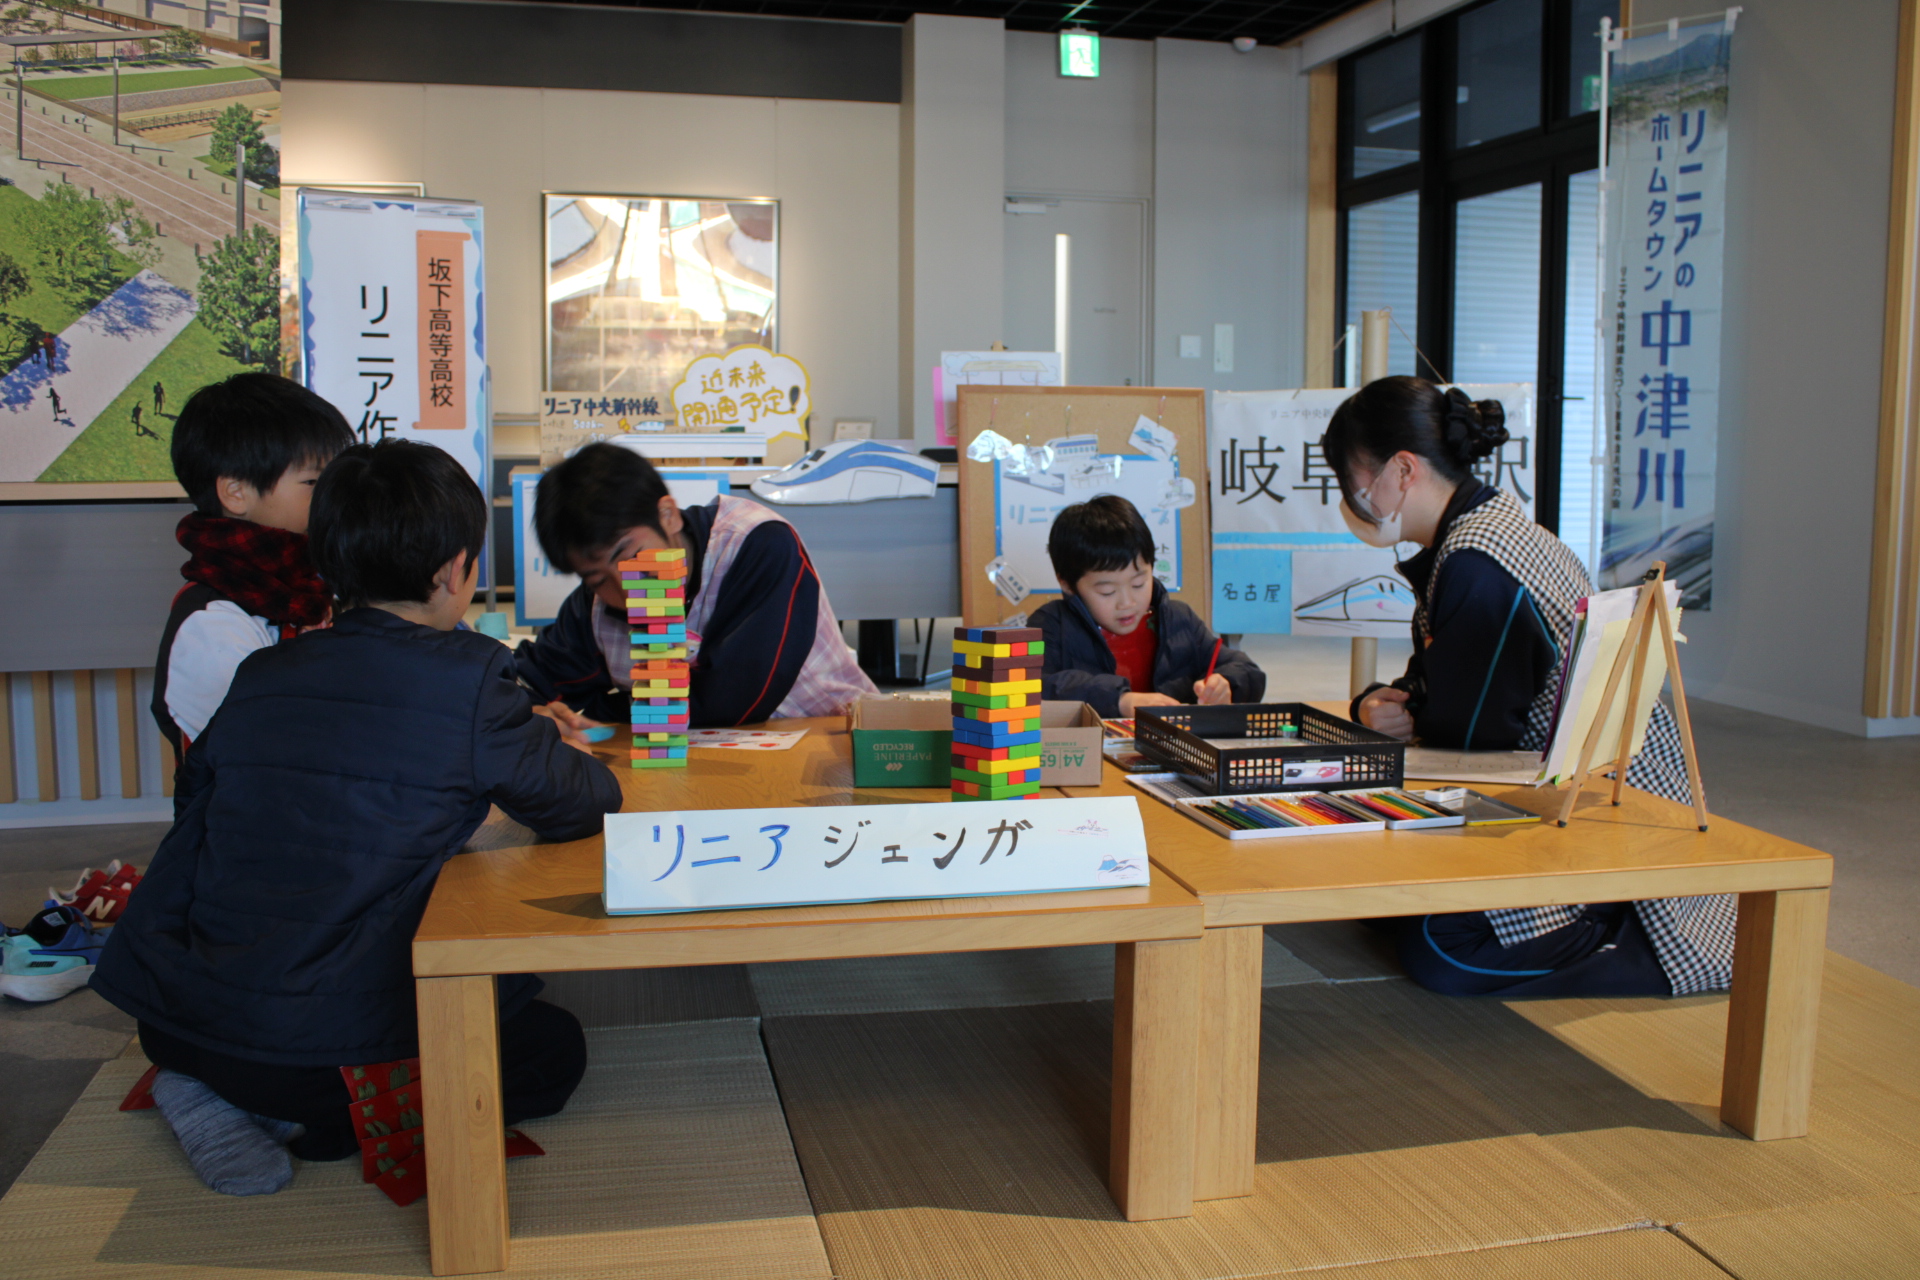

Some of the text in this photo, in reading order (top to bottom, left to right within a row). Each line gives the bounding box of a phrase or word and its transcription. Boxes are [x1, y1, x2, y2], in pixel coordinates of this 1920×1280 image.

[1644, 113, 1671, 292] ホームタウン
[1675, 109, 1706, 288] リニアの
[428, 257, 453, 408] 坂下高等高校
[357, 285, 397, 443] リニア作
[701, 360, 767, 395] 近未来
[544, 396, 661, 417] リニア中央新幹線
[1633, 299, 1691, 510] 中津川
[1222, 583, 1281, 603] 名古屋
[872, 743, 914, 751] RECYCLED
[873, 752, 933, 761] PAPERLINE
[1063, 754, 1085, 767] A4
[83, 895, 117, 920] N
